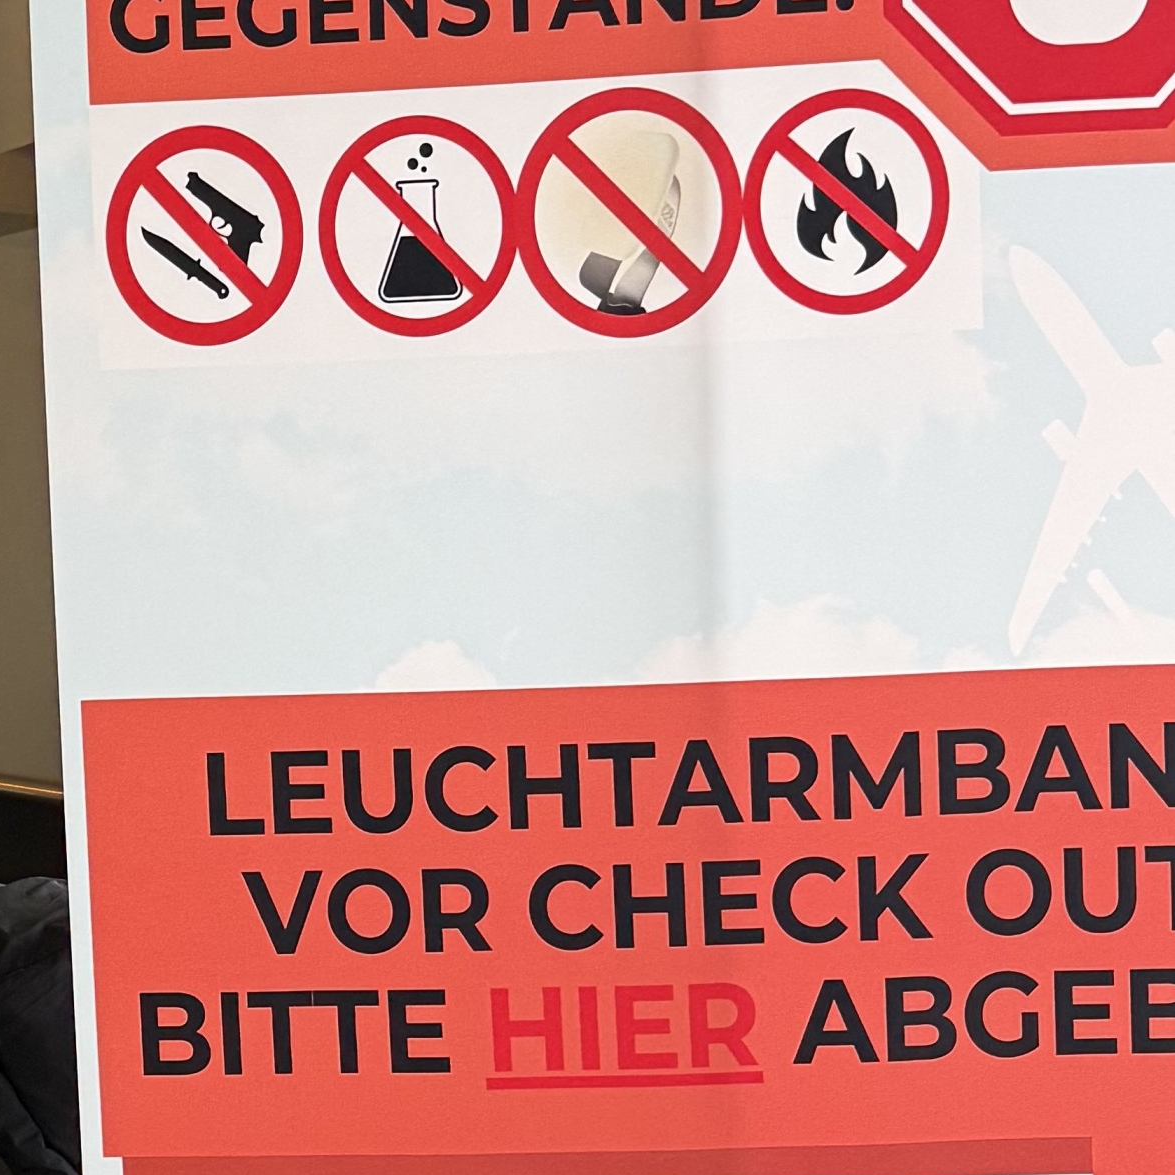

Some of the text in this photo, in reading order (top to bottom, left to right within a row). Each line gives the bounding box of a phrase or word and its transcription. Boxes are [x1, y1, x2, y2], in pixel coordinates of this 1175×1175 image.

[206, 721, 1175, 836] LEUCHTARMBAN
[241, 868, 492, 955] VOR
[528, 853, 933, 951] CHECK
[139, 968, 1175, 1076] BITTE HIER ABGEB
